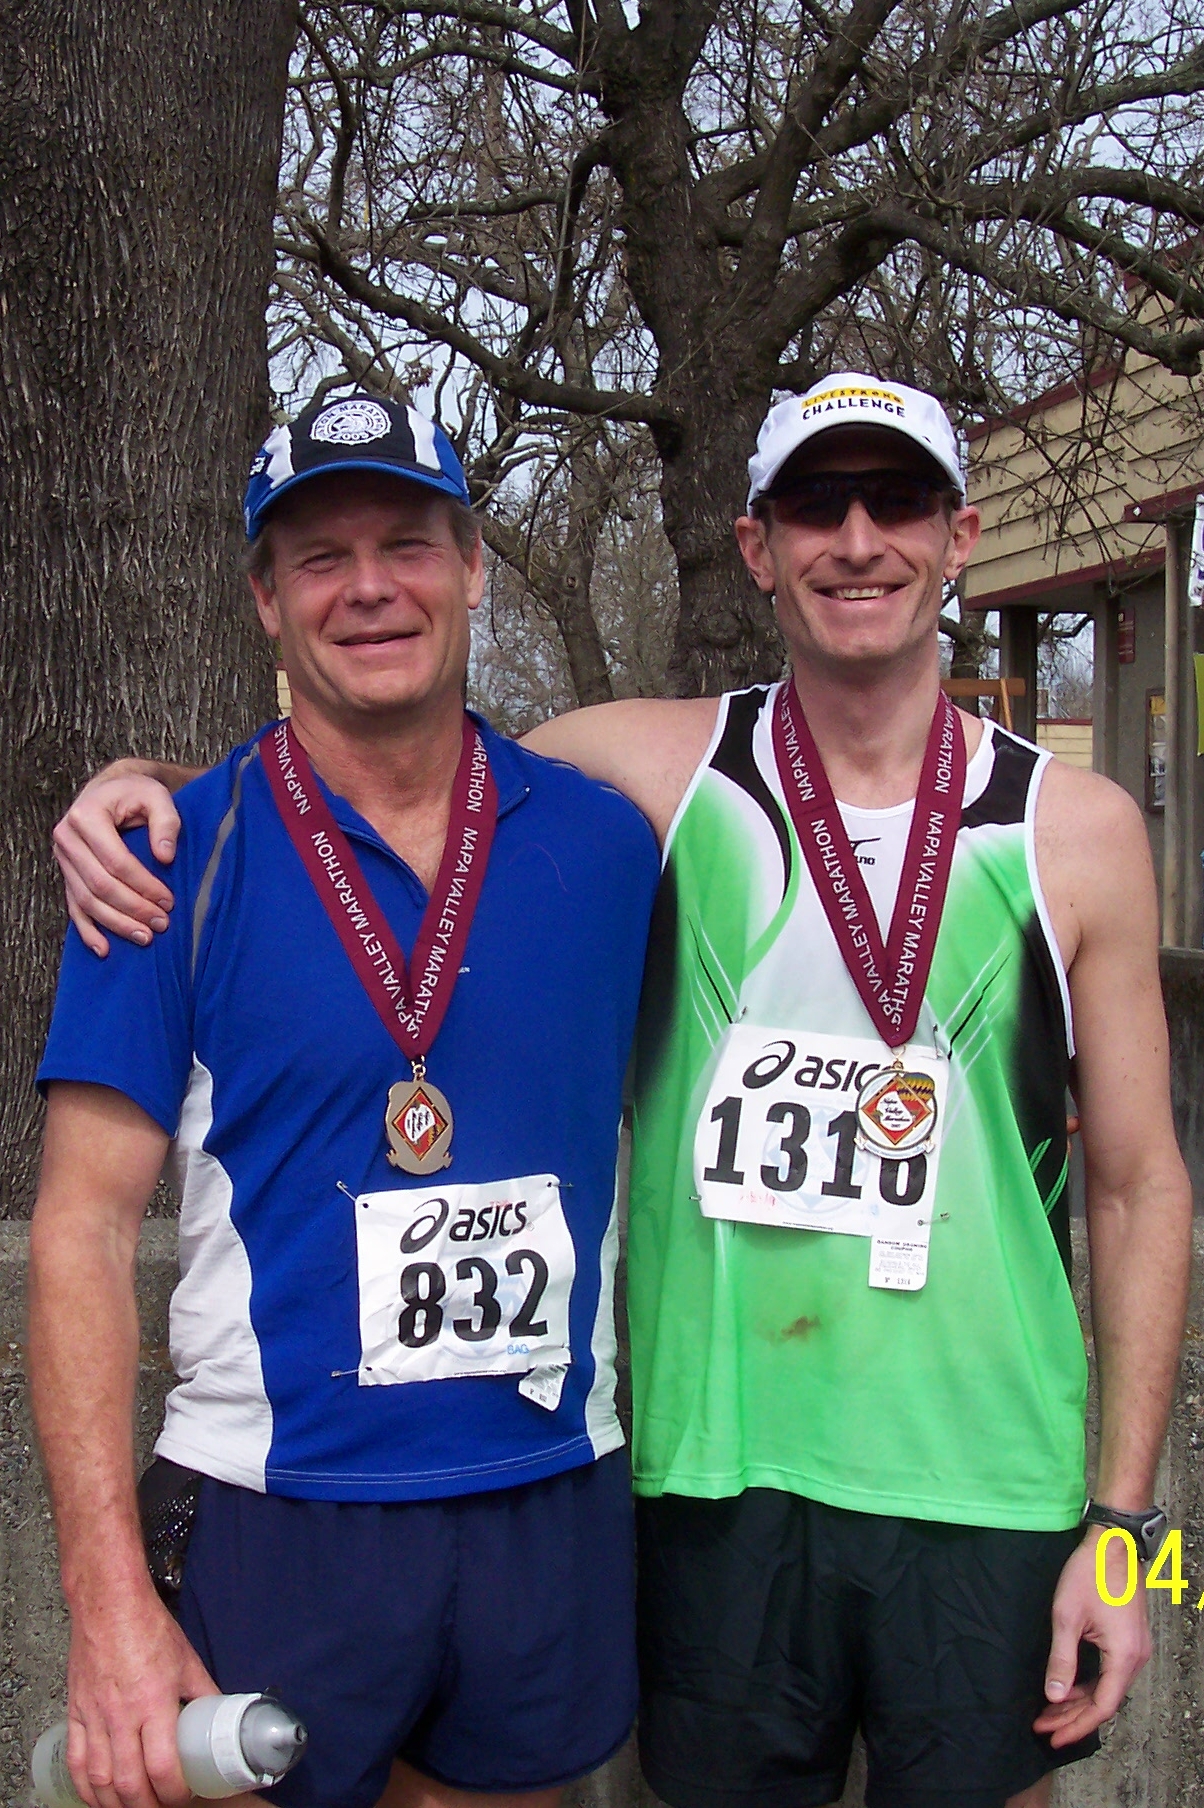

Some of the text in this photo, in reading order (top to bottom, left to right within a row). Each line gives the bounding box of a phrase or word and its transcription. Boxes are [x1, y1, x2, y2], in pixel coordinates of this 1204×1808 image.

[802, 398, 906, 421] CHALLENGE
[804, 388, 902, 407] LIVESTRONG
[274, 724, 312, 815] NAPA VALLE
[789, 756, 816, 802] NAPA
[310, 830, 370, 931] MARATHON
[455, 826, 479, 873] NAPA
[811, 818, 860, 921] MARATHON
[436, 878, 467, 945] VALLEY
[891, 810, 946, 1013] NAPA VALLEY MARATH
[358, 932, 402, 999] VALLEY
[413, 944, 448, 1023] MARATH
[848, 922, 882, 991] VALLEY
[794, 1054, 892, 1092] asic
[449, 1200, 527, 1241] asics
[398, 1249, 550, 1348] 832
